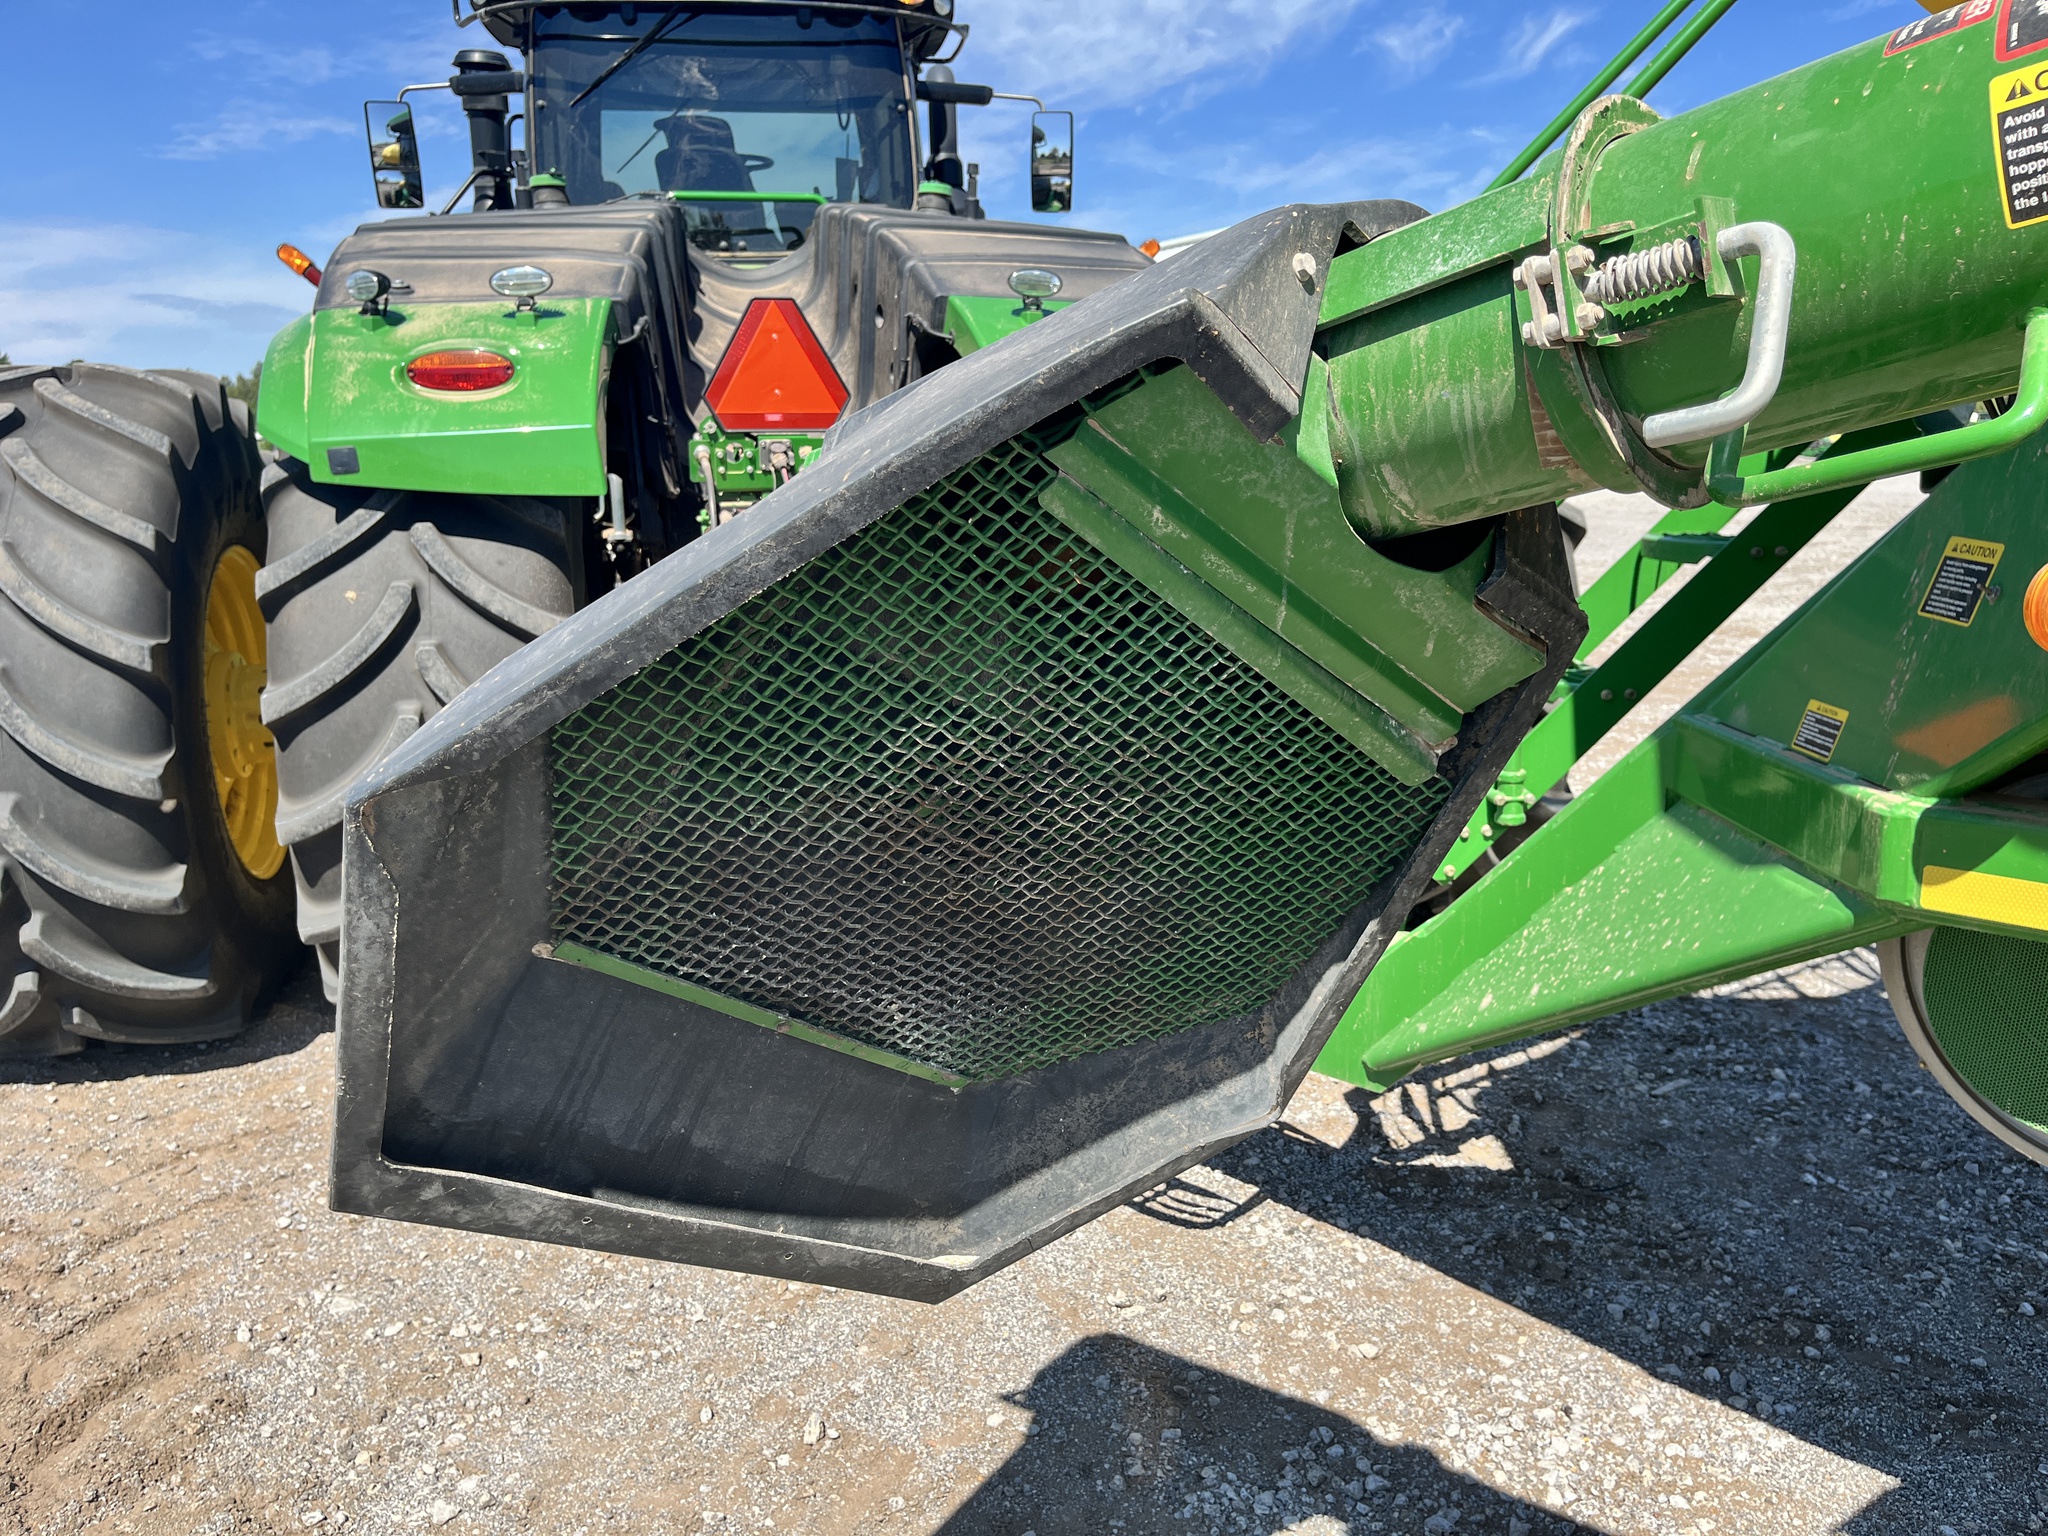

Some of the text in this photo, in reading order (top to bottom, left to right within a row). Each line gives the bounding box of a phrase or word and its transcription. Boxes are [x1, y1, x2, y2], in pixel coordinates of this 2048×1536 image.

[2004, 106, 2045, 129] Avoid
[2005, 125, 2038, 144] with
[2009, 158, 2048, 177] hopp
[2014, 197, 2039, 211] the
[1959, 544, 1998, 559] CAUTION
